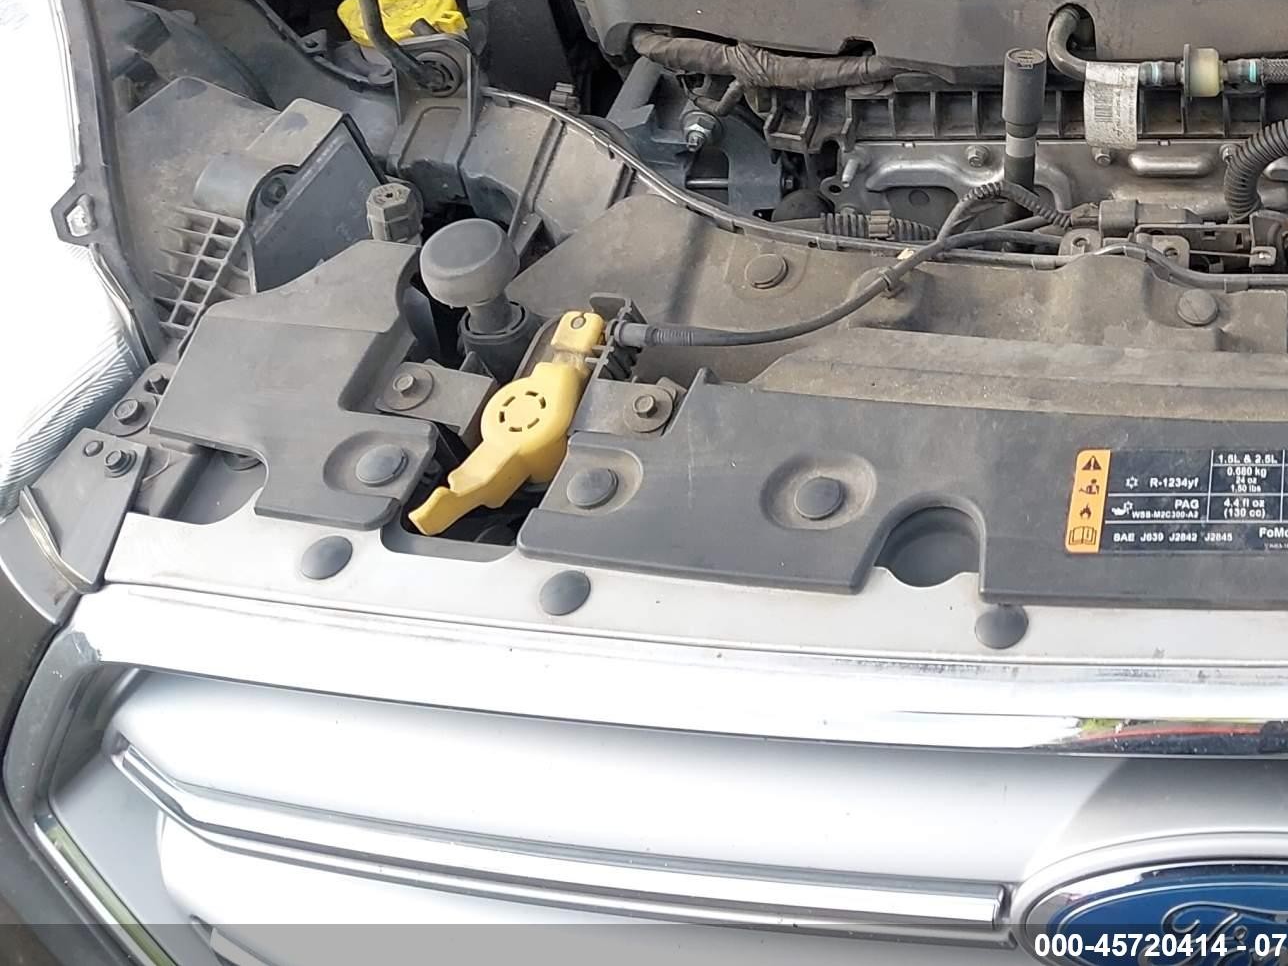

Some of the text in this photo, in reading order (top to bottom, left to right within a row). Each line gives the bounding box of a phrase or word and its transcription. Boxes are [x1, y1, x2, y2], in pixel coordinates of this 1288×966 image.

[1243, 454, 1252, 464] &
[1254, 466, 1267, 478] kg
[1149, 476, 1199, 491] R-1234yf
[1174, 499, 1200, 510] PAG
[1223, 498, 1265, 508] 4.4 fl oz
[1223, 508, 1266, 519] (130 cc)
[1113, 533, 1136, 543] SAE
